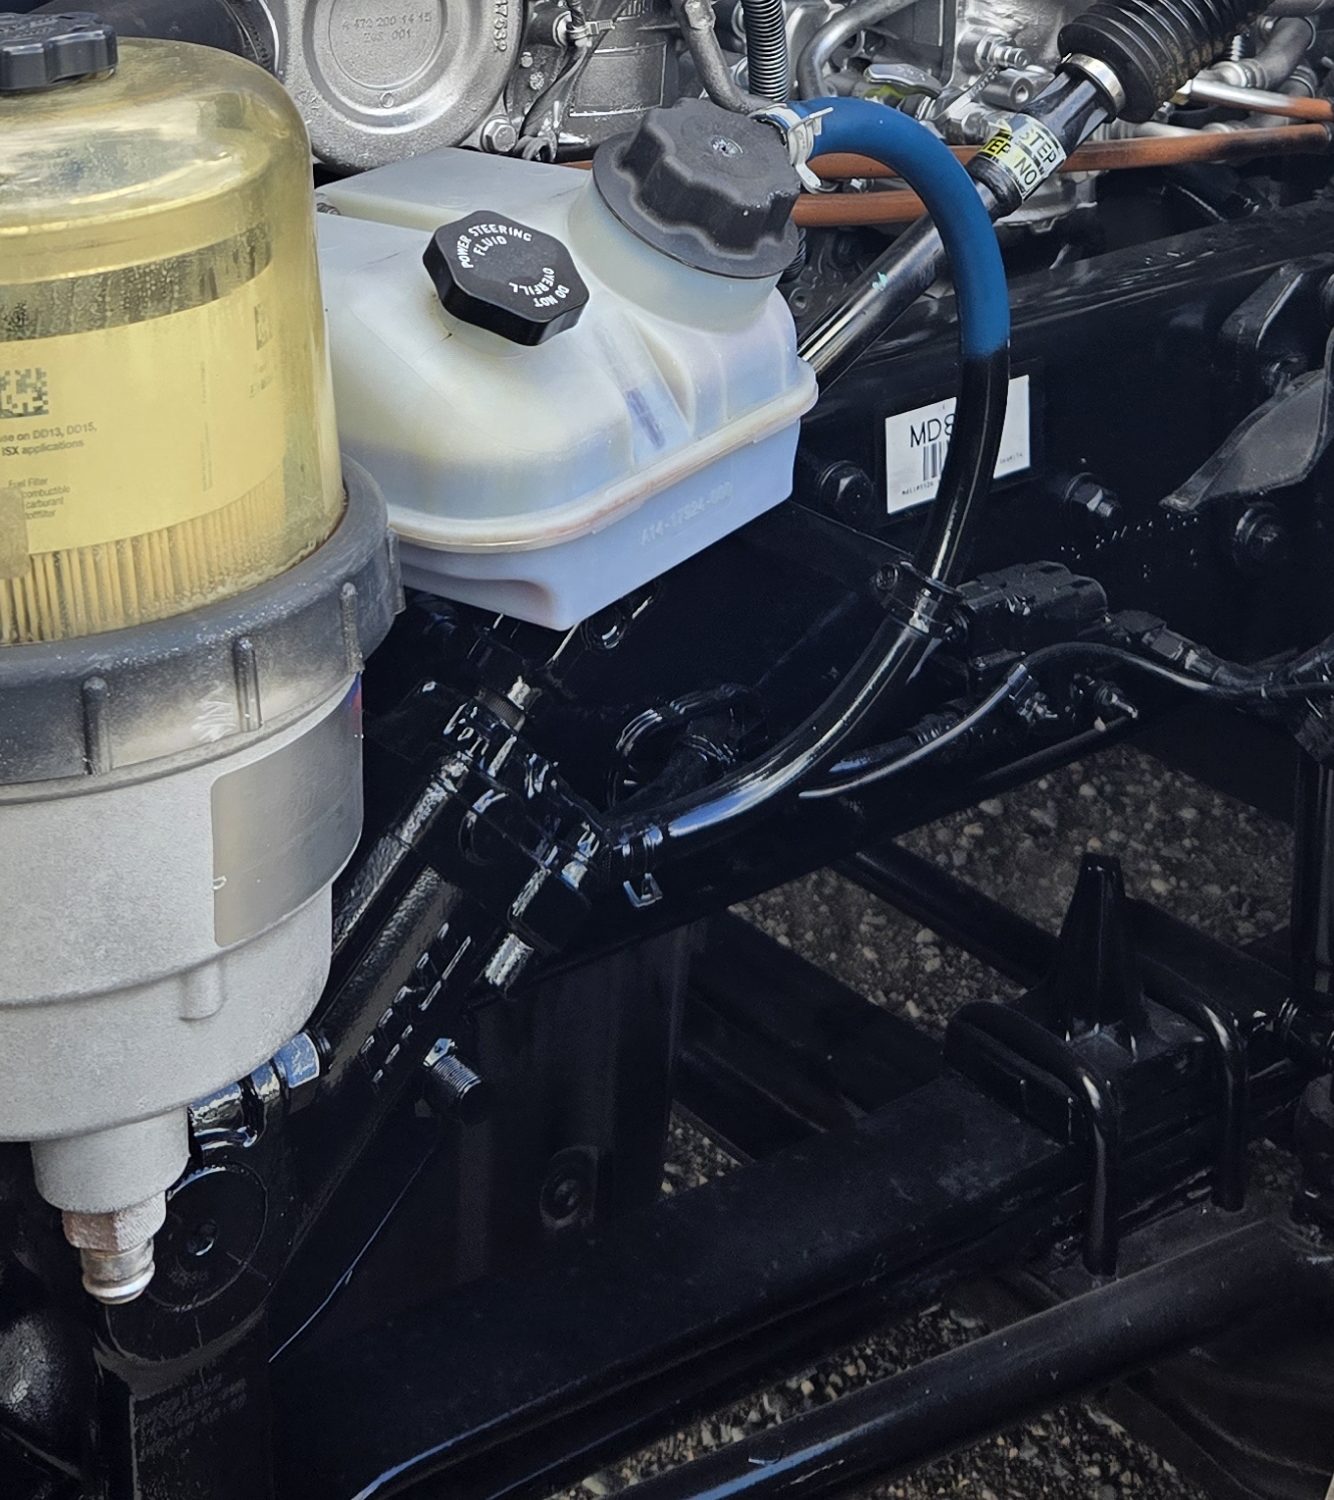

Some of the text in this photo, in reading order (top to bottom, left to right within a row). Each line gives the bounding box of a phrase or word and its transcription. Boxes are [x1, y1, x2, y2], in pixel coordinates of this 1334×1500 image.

[376, 16, 397, 27] 200
[401, 14, 415, 26] 14
[391, 29, 411, 40] 001
[1013, 156, 1038, 186] NO
[457, 224, 533, 269] POWER STEERING
[473, 235, 507, 256] FLUID
[508, 267, 555, 296] OVERFILL
[533, 284, 570, 308] DO NOT
[17, 433, 31, 441] on
[32, 427, 65, 440] DD13,
[66, 422, 98, 436] DD15,
[2, 446, 20, 457] ISX
[21, 439, 85, 456] applications
[8, 477, 49, 489] Fuel Filter
